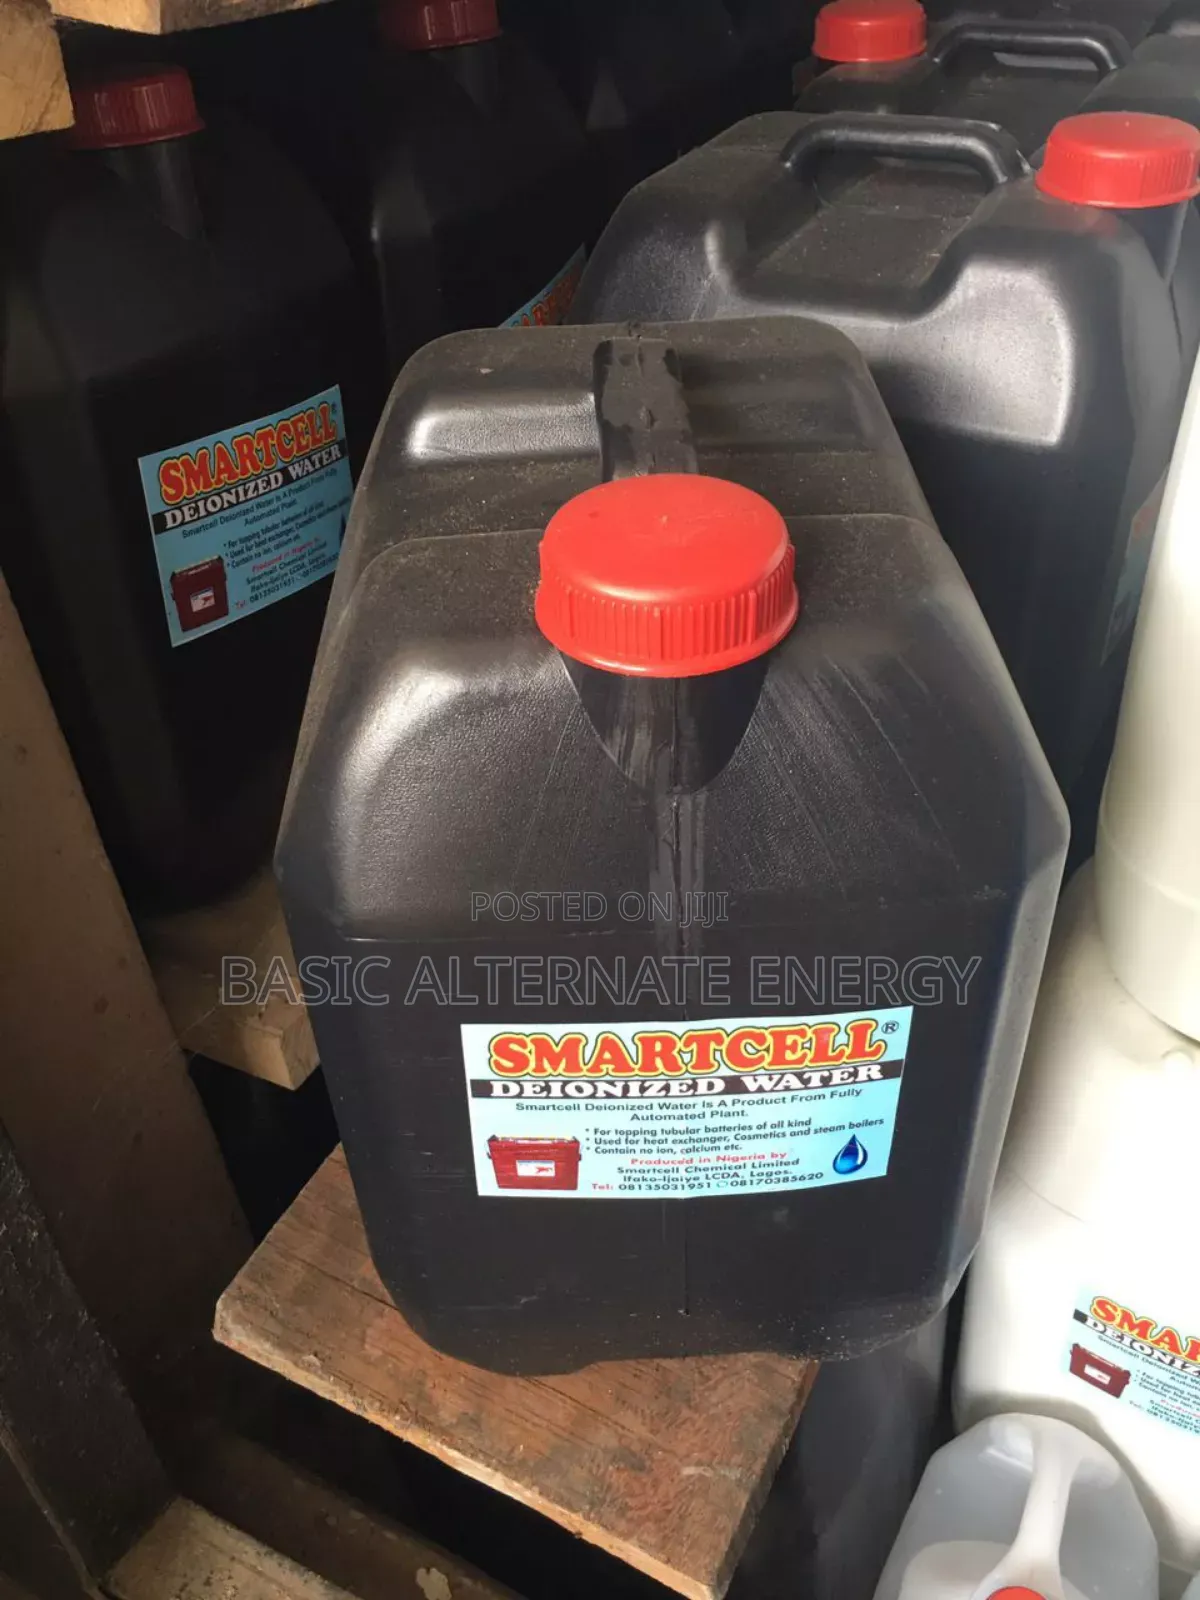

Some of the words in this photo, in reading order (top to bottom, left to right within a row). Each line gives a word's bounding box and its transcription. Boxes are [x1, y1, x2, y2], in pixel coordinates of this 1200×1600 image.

[164, 472, 283, 530] DEIONIZED
[288, 445, 341, 480] WATER
[490, 1078, 725, 1098] DEIONIZED
[740, 1065, 884, 1092] WATER
[516, 1102, 581, 1111] Smartcell
[585, 1102, 654, 1111] Deionized
[658, 1102, 698, 1111] Water
[702, 1100, 713, 1108] Is
[717, 1099, 728, 1108] A
[732, 1096, 786, 1107] Product
[791, 1093, 826, 1103] From
[830, 1087, 863, 1099] Fully
[630, 1111, 706, 1121] Automated
[710, 1109, 749, 1119] Plant.
[594, 1128, 611, 1136] For
[615, 1127, 657, 1138] topping
[661, 1126, 701, 1135] tubular
[704, 1122, 756, 1134] batteries
[756, 1121, 767, 1131] of
[770, 1120, 784, 1130] all
[787, 1118, 812, 1128] kind
[594, 1137, 621, 1145] Used
[624, 1136, 640, 1145] for
[643, 1136, 668, 1145] heat
[671, 1134, 730, 1146] exchanger,
[734, 1131, 786, 1142] Cosmetics
[790, 1128, 811, 1138] and
[813, 1124, 846, 1135] steam
[848, 1118, 885, 1130] boilers
[595, 1146, 636, 1155] Contain
[640, 1147, 654, 1155] no
[657, 1146, 677, 1156] ion,
[680, 1145, 721, 1155] calcium
[724, 1143, 743, 1152] etc.
[631, 1157, 694, 1165] Produced
[699, 1155, 711, 1163] in
[716, 1153, 767, 1164] Nigeria
[770, 1151, 787, 1161] by
[617, 1166, 680, 1174] Smartcell
[685, 1163, 747, 1173] Chemical
[751, 1158, 800, 1170] Limited
[592, 1183, 613, 1191] Tel:
[618, 1183, 711, 1191] 08135031951
[730, 1172, 824, 1188] 08170385620
